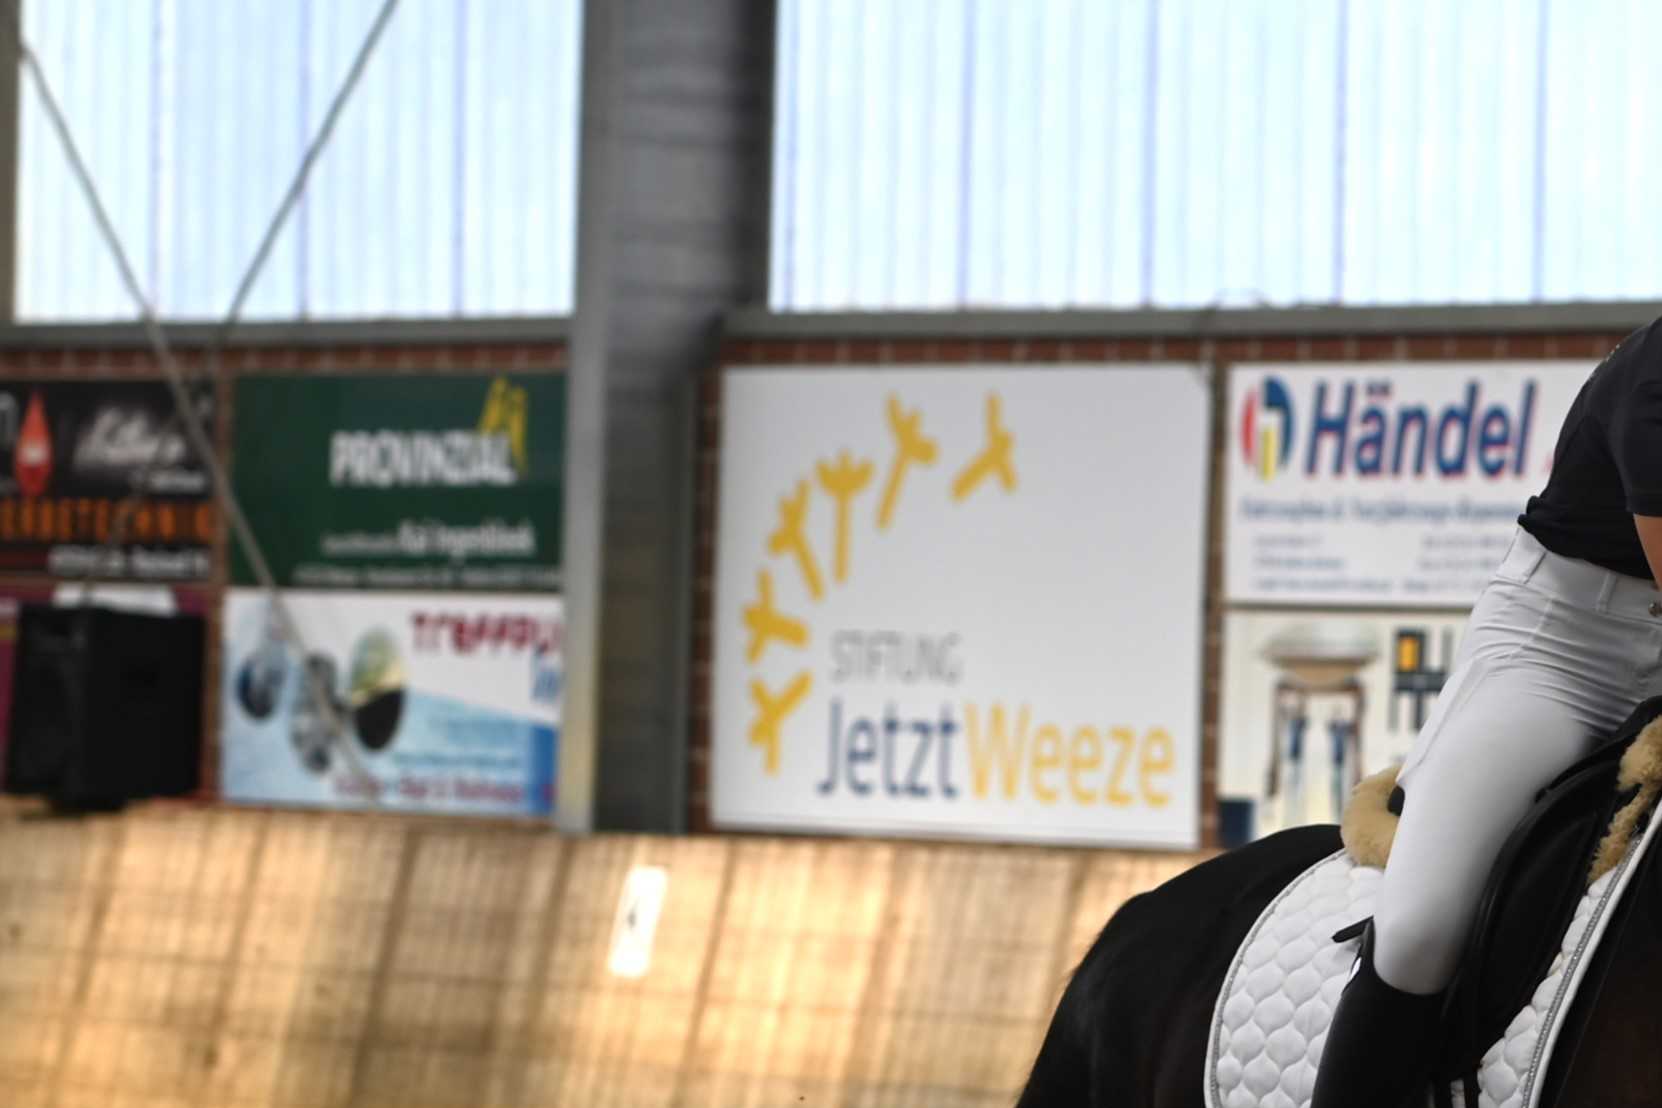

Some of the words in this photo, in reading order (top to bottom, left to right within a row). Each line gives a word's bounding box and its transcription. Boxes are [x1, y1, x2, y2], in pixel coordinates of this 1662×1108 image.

[1306, 380, 1538, 479] Händel
[330, 430, 517, 488] PROVINZIAL
[830, 630, 961, 684] STIFTUNG
